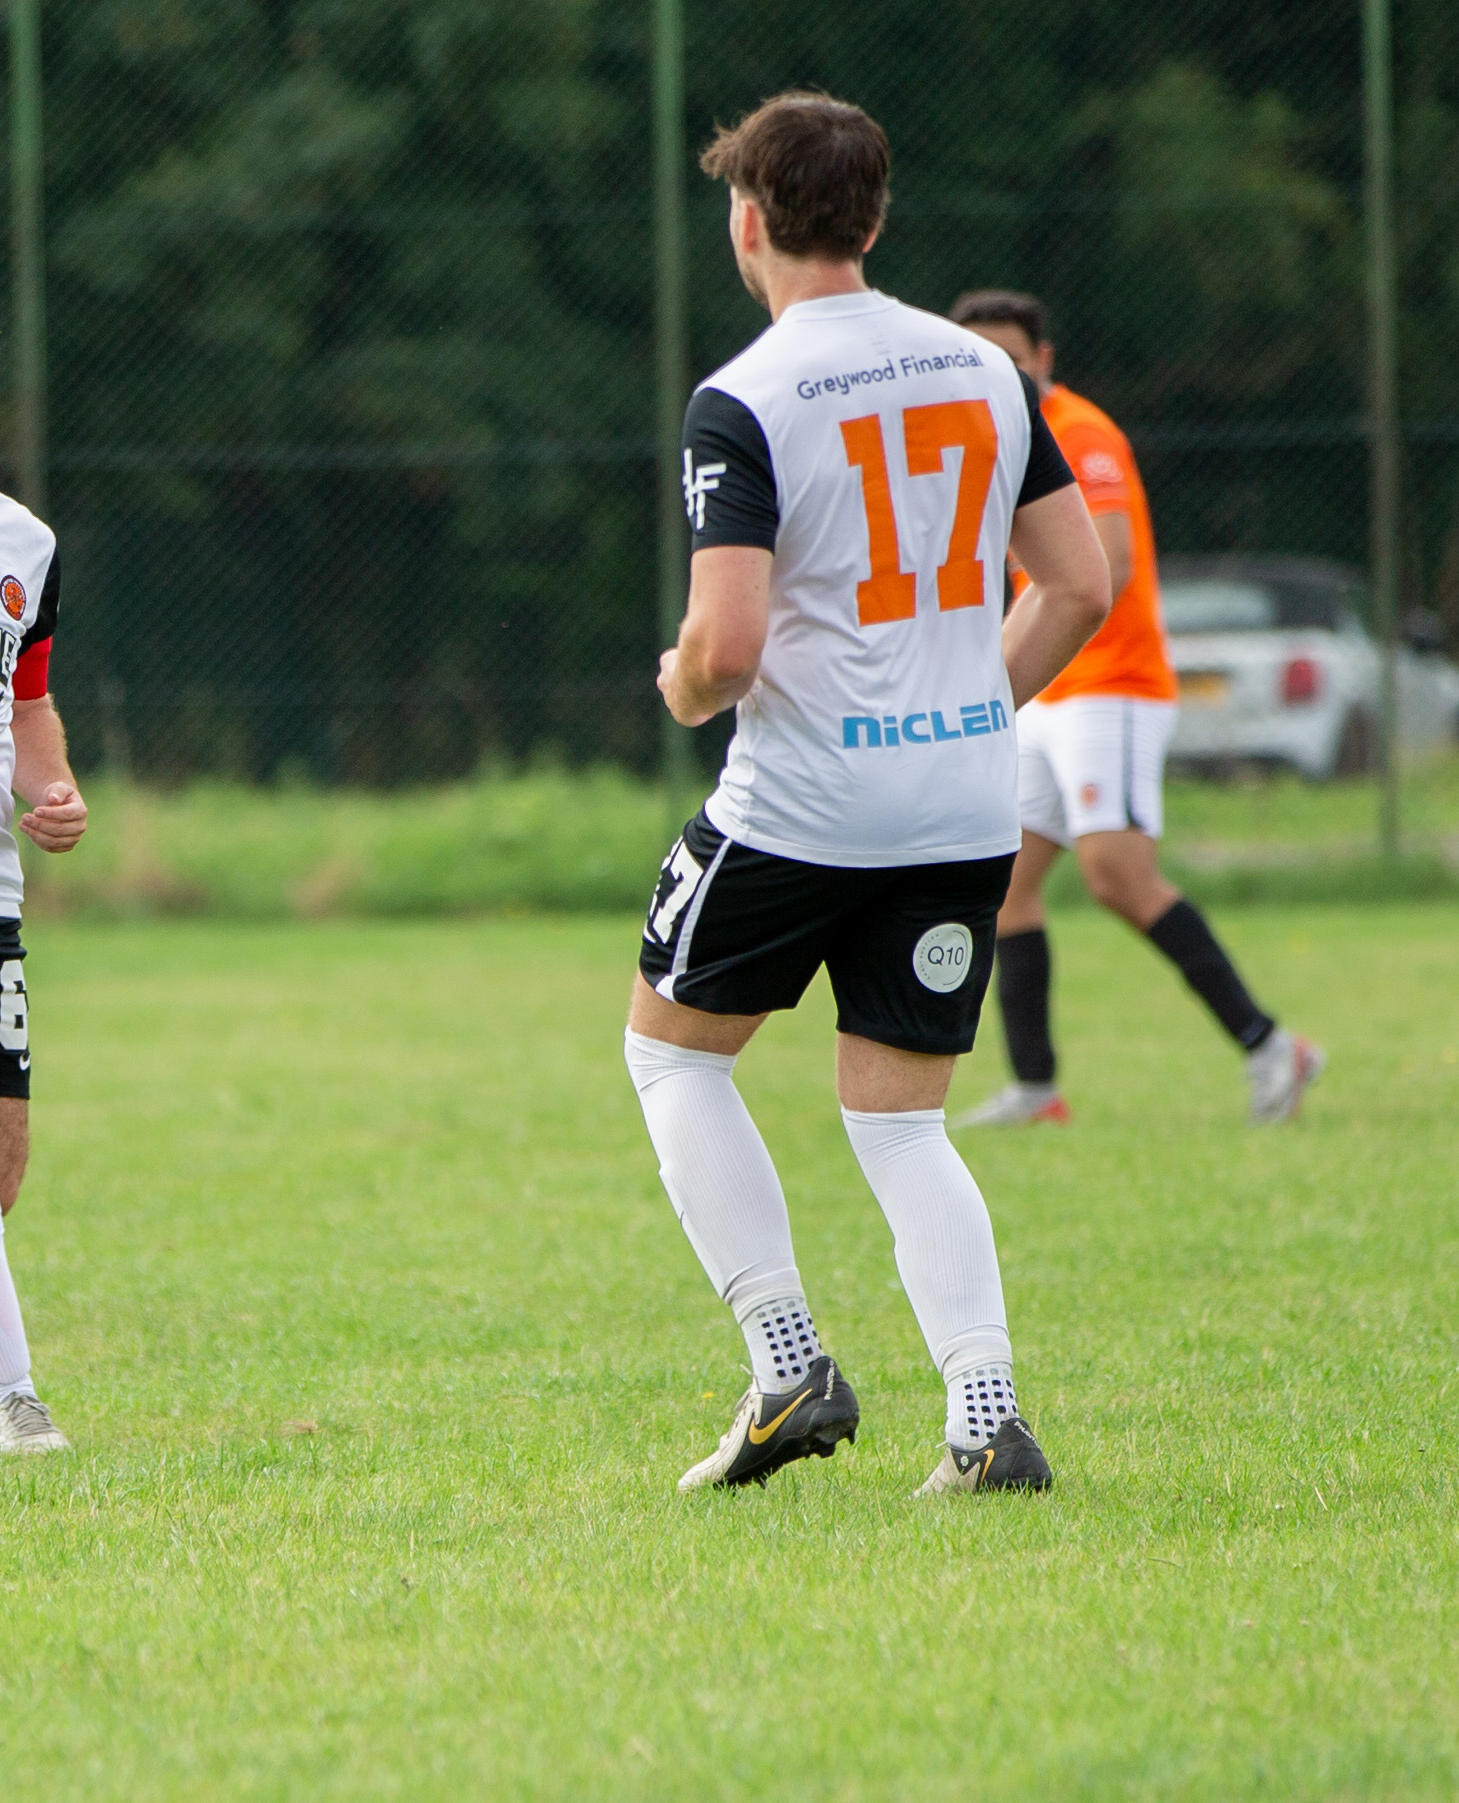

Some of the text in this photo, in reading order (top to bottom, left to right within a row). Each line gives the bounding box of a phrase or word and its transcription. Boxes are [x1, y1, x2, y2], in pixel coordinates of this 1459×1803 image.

[797, 348, 984, 400] Greywood Financial
[839, 398, 999, 627] 17
[927, 945, 965, 966] Q10
